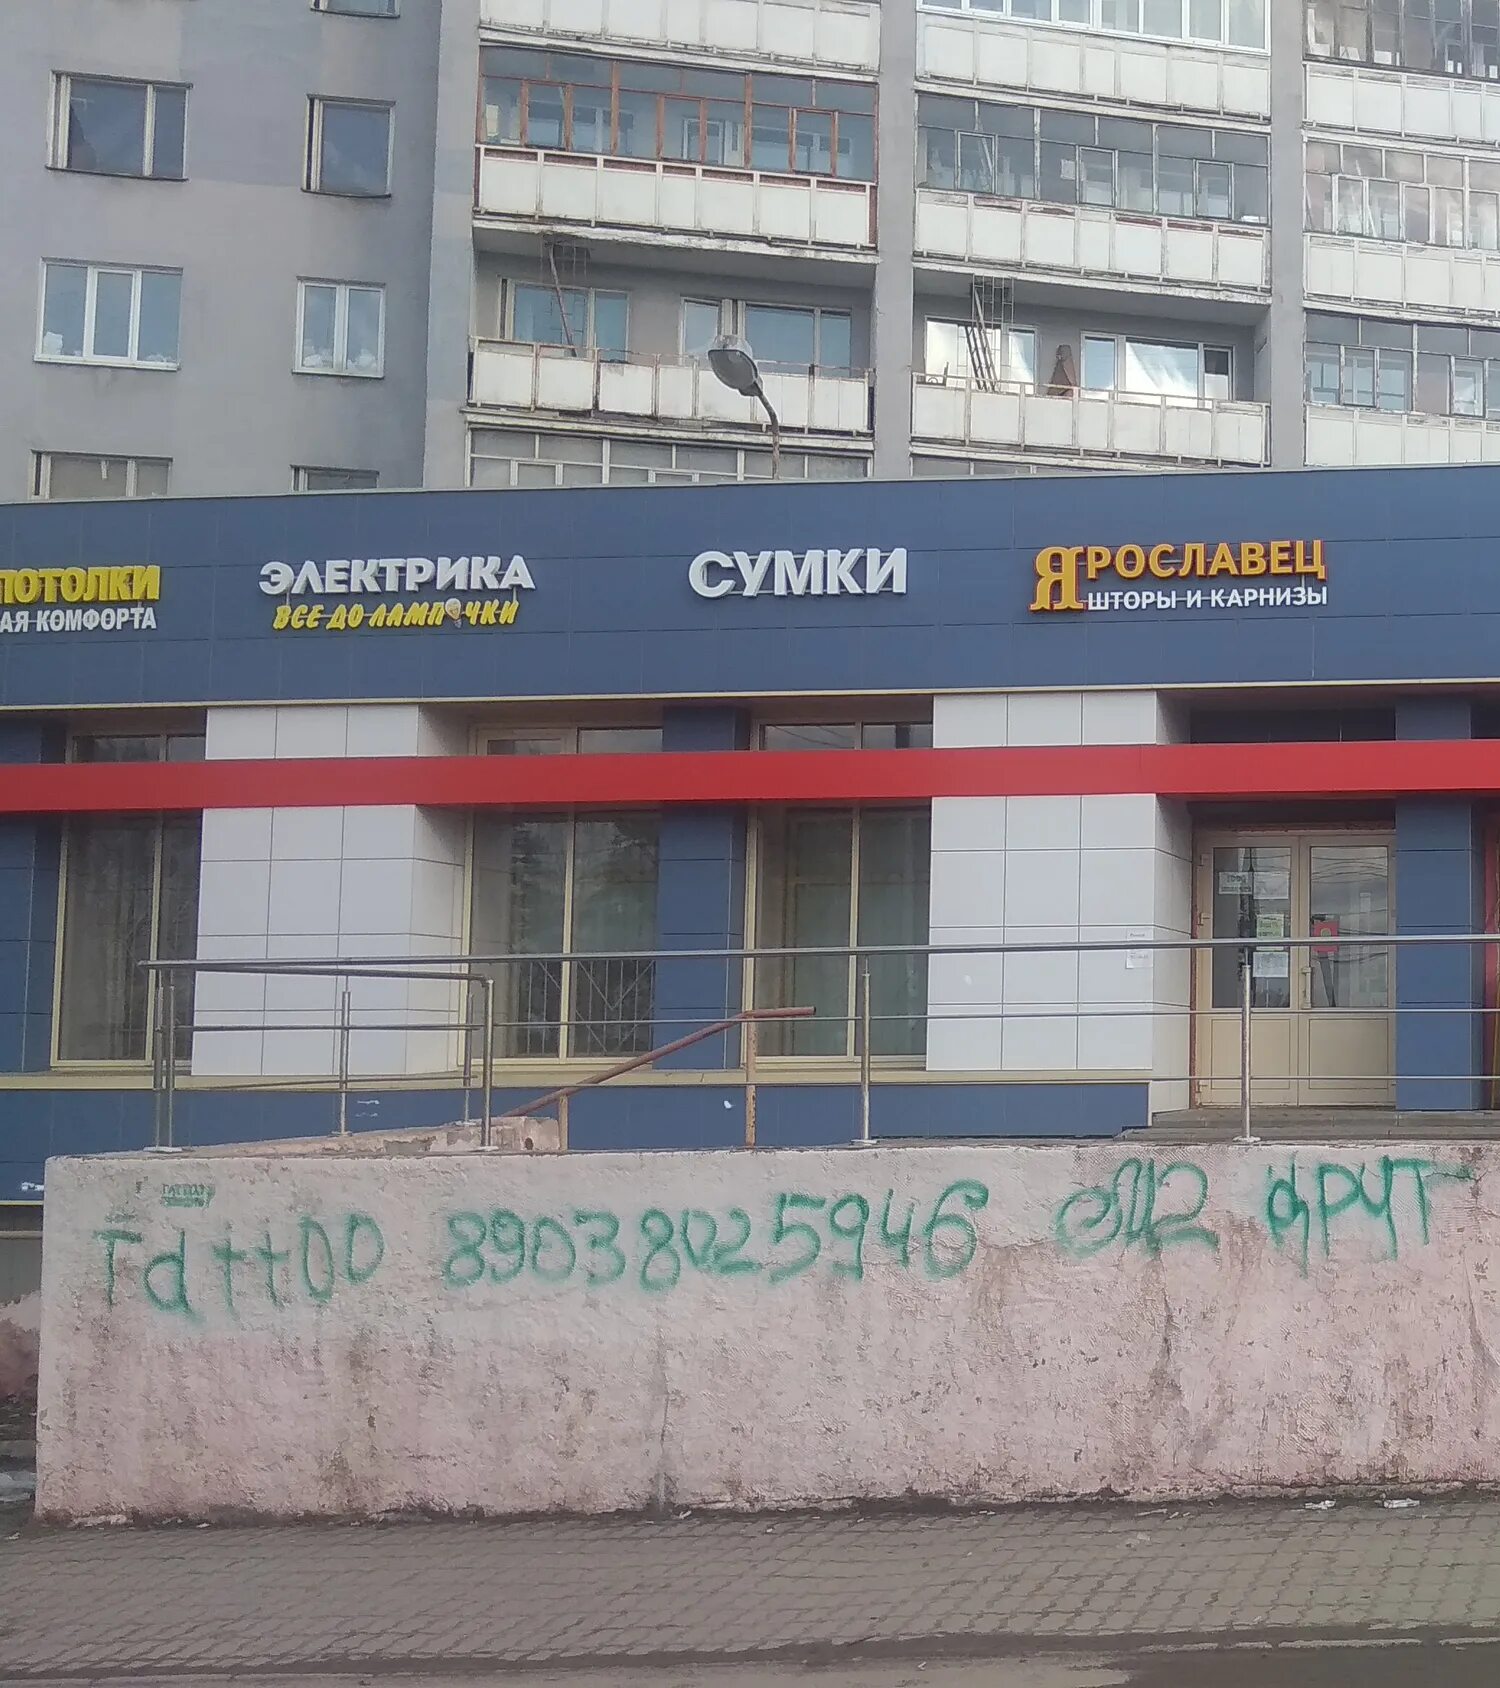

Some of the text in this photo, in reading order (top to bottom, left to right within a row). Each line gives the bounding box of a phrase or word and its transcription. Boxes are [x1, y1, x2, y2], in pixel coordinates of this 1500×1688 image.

[0, 565, 161, 604] ПОТОЛКИ
[258, 555, 536, 595] ЭЛЕКТРИКА
[688, 547, 908, 599] СУМКИ
[1029, 539, 1327, 612] ЯРОСЛАВЕЦ
[272, 603, 325, 630] ВСЕ
[325, 603, 365, 631] ДО
[1087, 586, 1328, 611] ШТОРЫ И КАРНИЗЫ
[36, 607, 157, 633] КОМФОРТА
